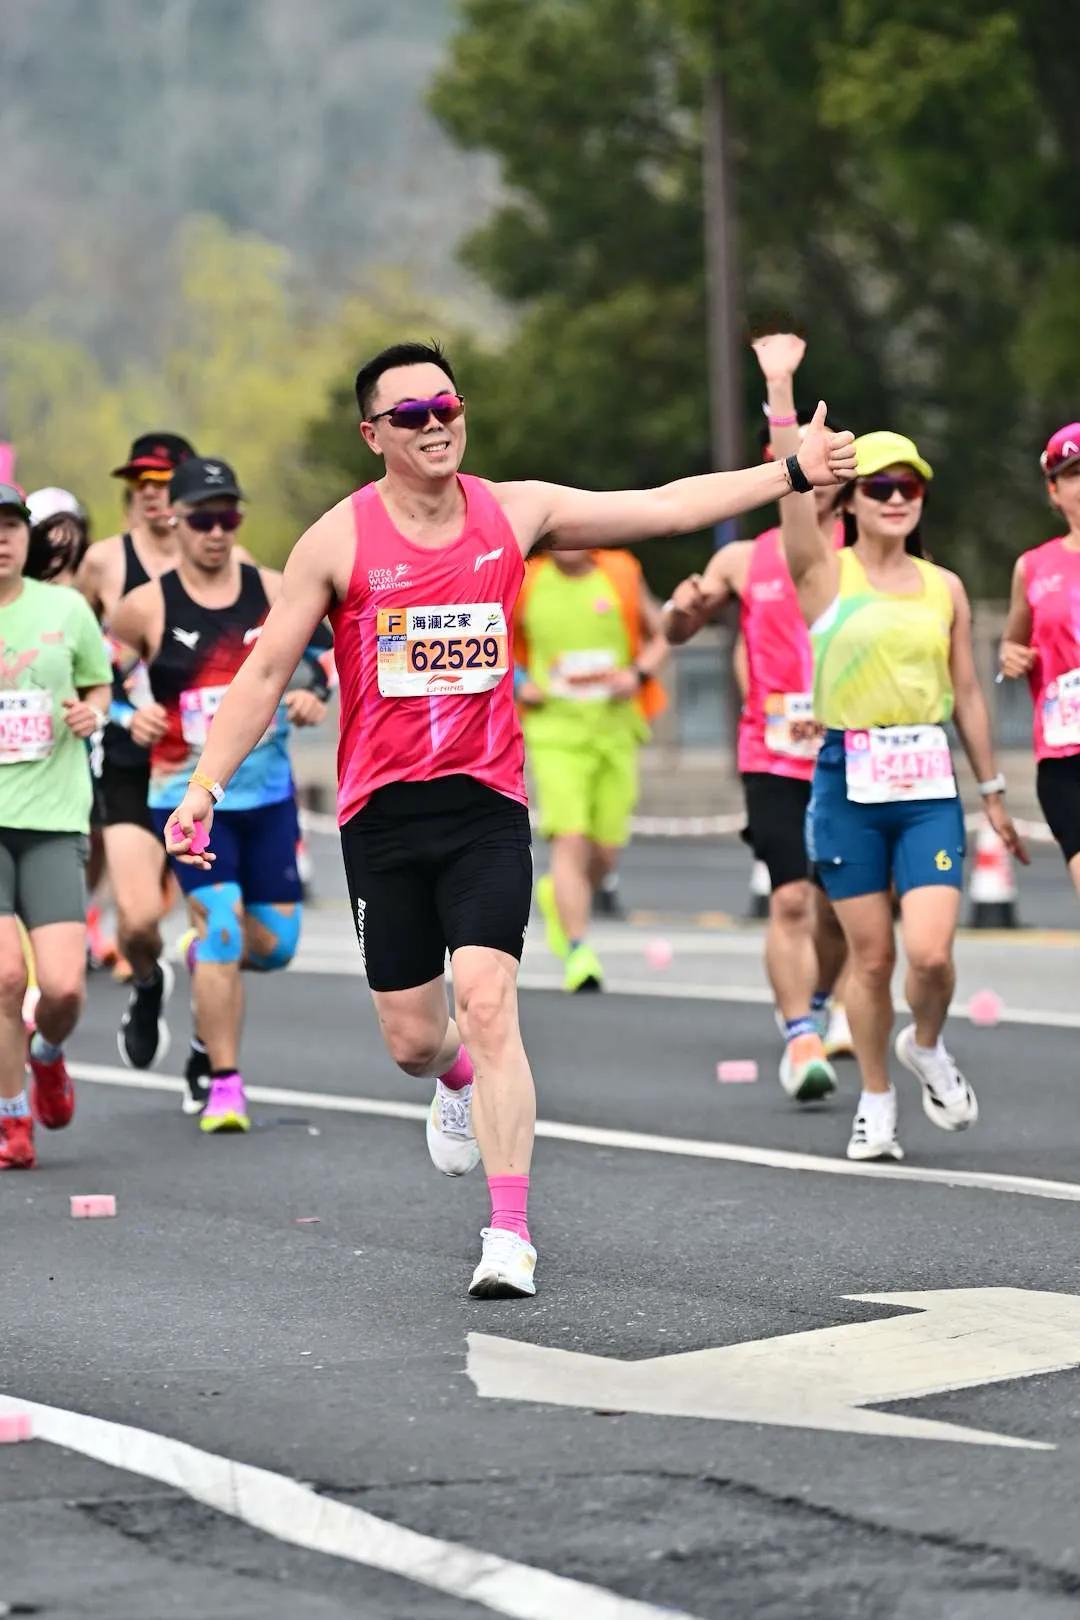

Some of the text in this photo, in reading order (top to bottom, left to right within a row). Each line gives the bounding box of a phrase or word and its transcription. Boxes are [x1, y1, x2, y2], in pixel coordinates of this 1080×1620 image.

[368, 569, 392, 578] 2026
[369, 577, 393, 585] WUXI
[370, 582, 413, 591] MARATHON
[389, 616, 402, 632] F
[412, 613, 472, 630] 海澜之家
[412, 638, 499, 671] 62529
